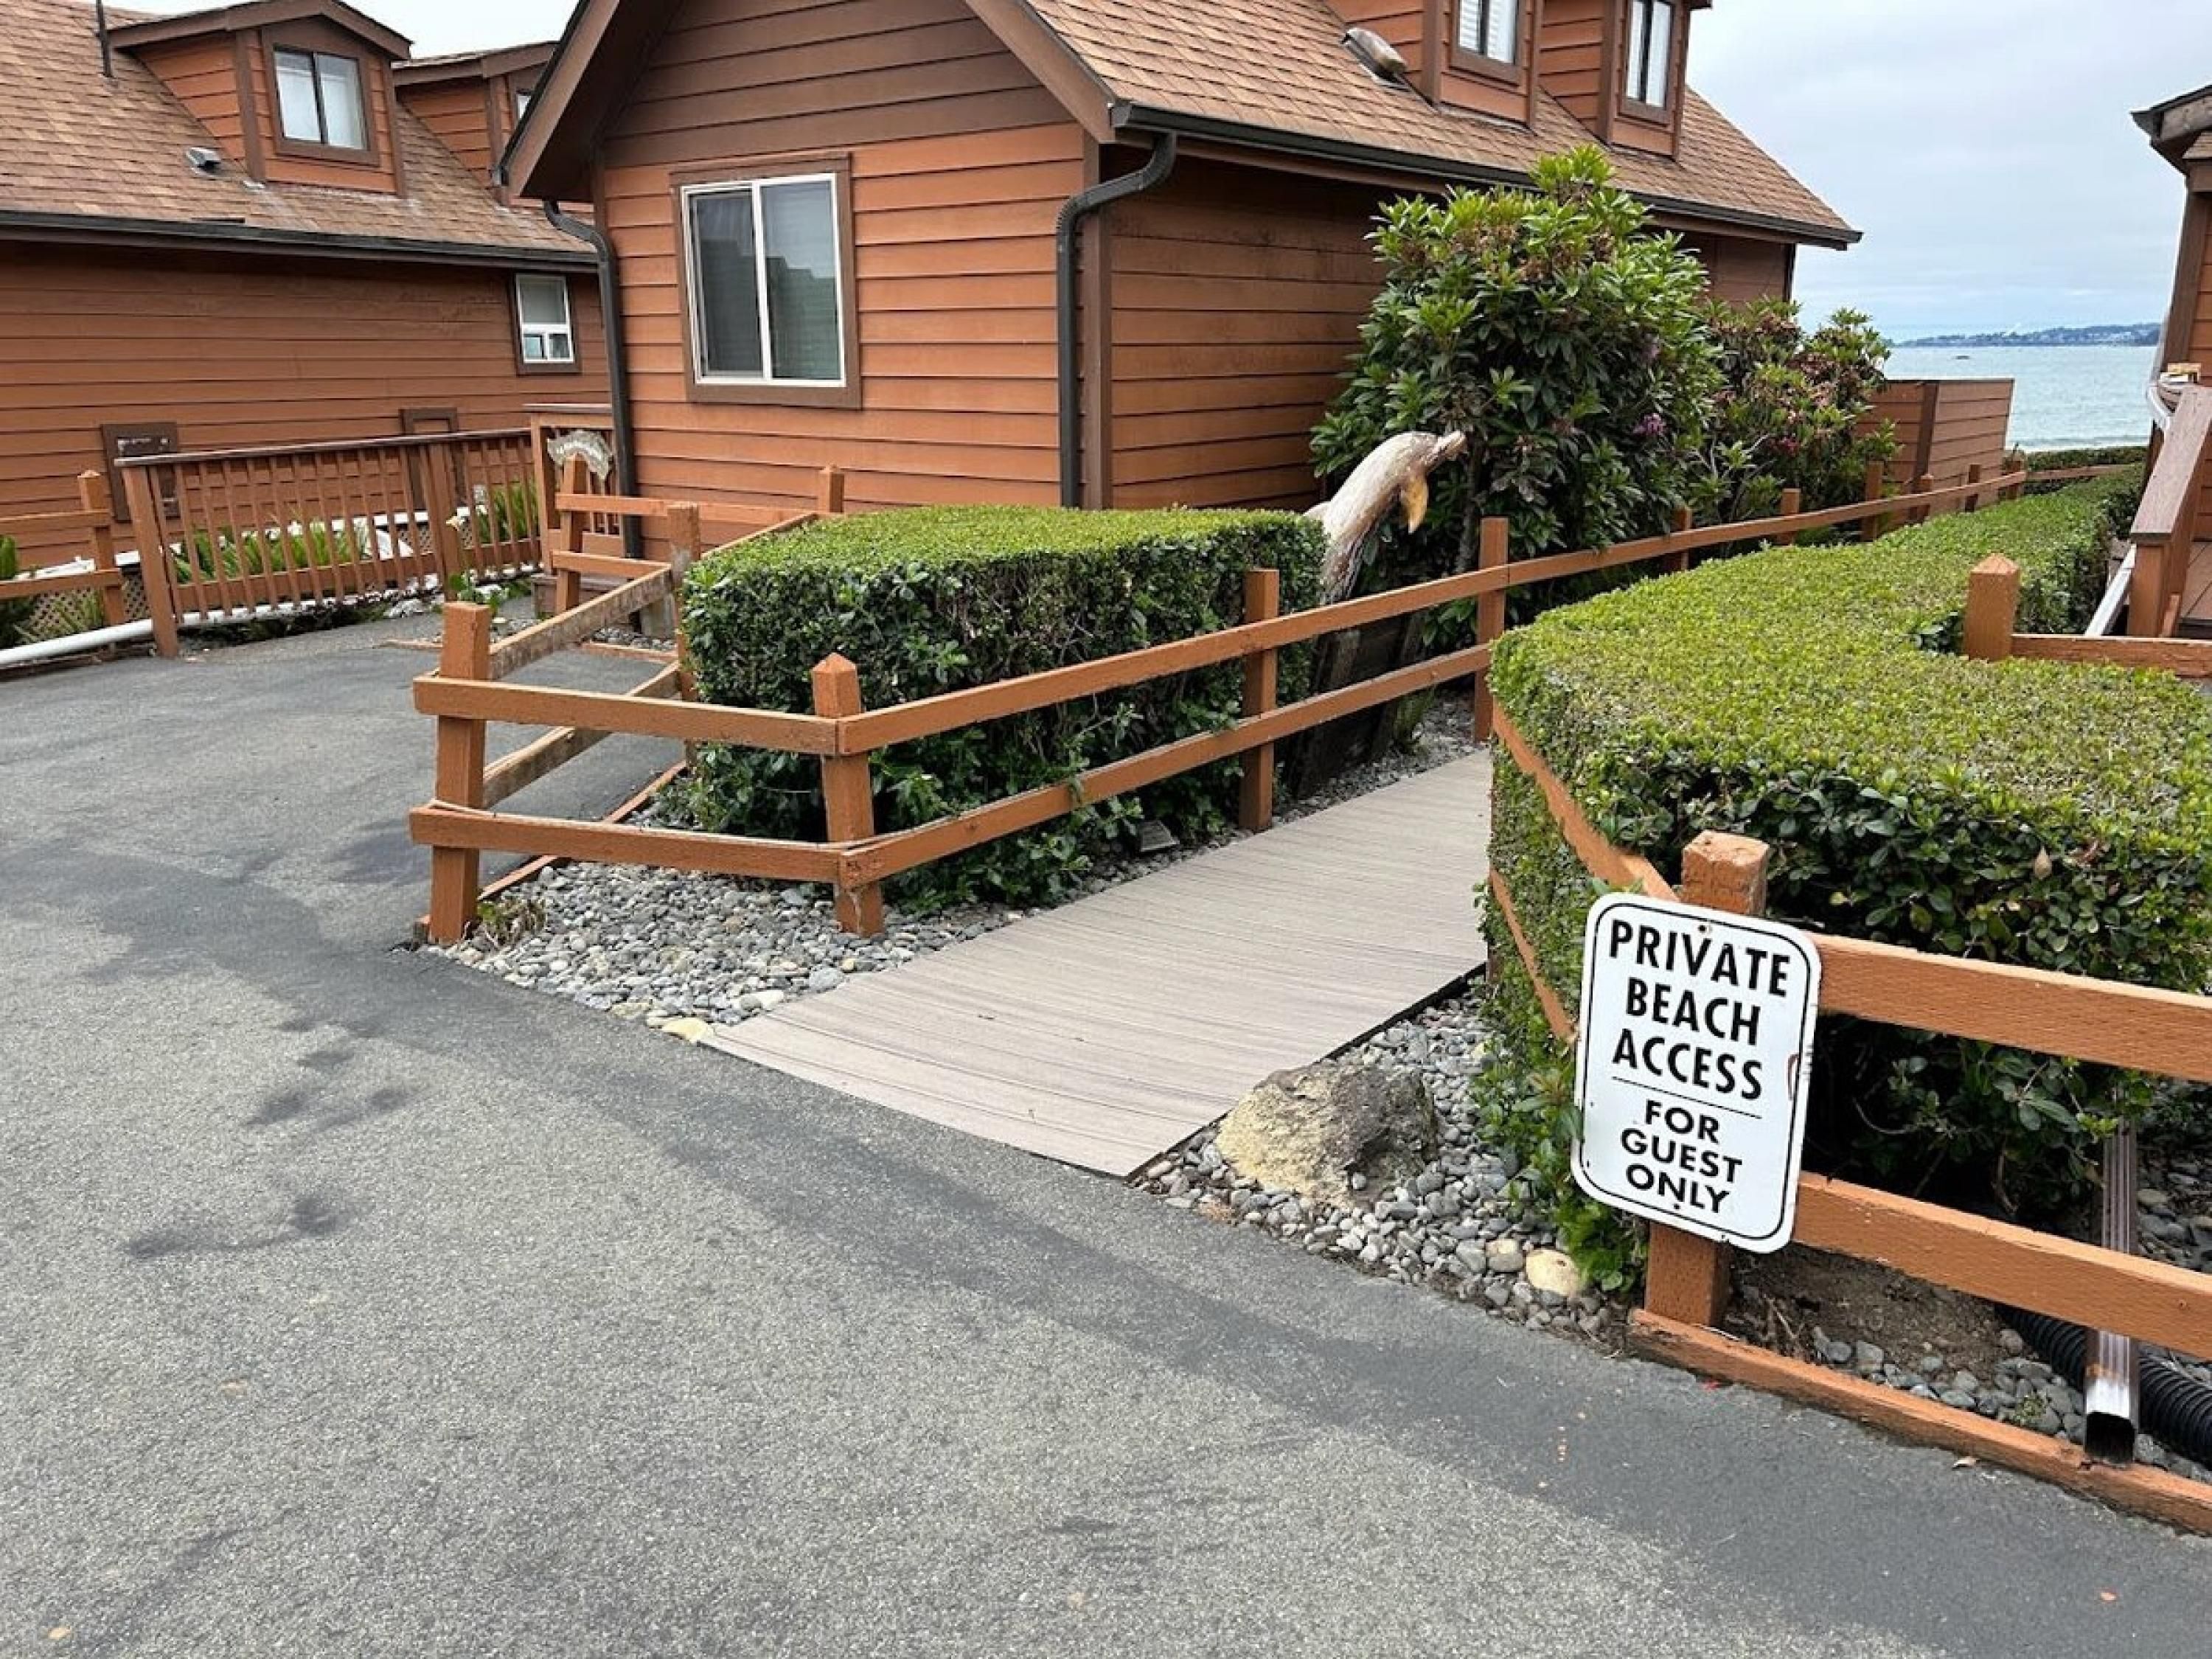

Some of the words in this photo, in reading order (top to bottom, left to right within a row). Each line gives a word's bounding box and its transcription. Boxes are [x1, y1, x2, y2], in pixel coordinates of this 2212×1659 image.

[1610, 919, 1790, 997] PRIVATE
[1626, 977, 1761, 1046] BEACH
[1612, 1029, 1762, 1100] ACCESS
[1646, 1100, 1719, 1144] FOR
[1621, 1129, 1742, 1183] GUEST
[1626, 1164, 1730, 1214] ONLY
